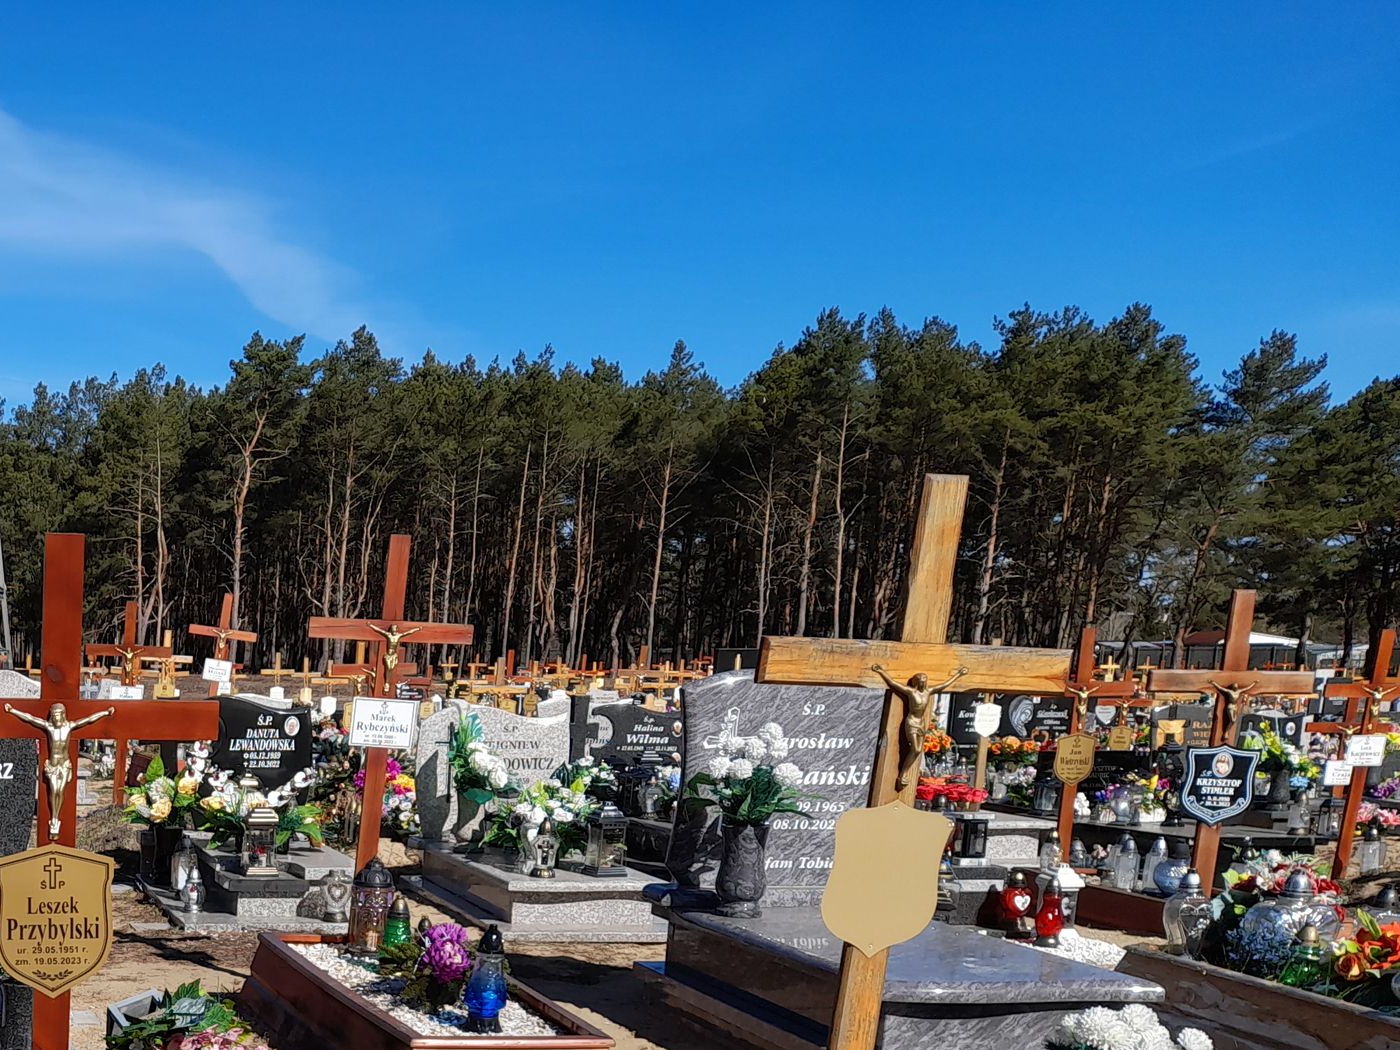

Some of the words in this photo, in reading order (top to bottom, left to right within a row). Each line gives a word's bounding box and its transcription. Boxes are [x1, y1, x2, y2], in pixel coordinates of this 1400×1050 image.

[802, 701, 826, 716] Ś.P.
[370, 713, 397, 722] Marek
[246, 728, 280, 739] DANUTA
[356, 721, 409, 735] Rybczyński
[633, 724, 665, 733] Halina
[229, 739, 296, 751] LEWANDOWSKA
[626, 734, 670, 745] Wilma
[781, 733, 855, 750] arosław
[1196, 777, 1243, 788] KRZYSZTOF
[763, 856, 793, 870] fam
[27, 896, 80, 915] Leszek
[6, 916, 100, 946] Przybylski
[32, 946, 80, 954] 29.05.1951
[34, 957, 82, 966] 19.05.2023
